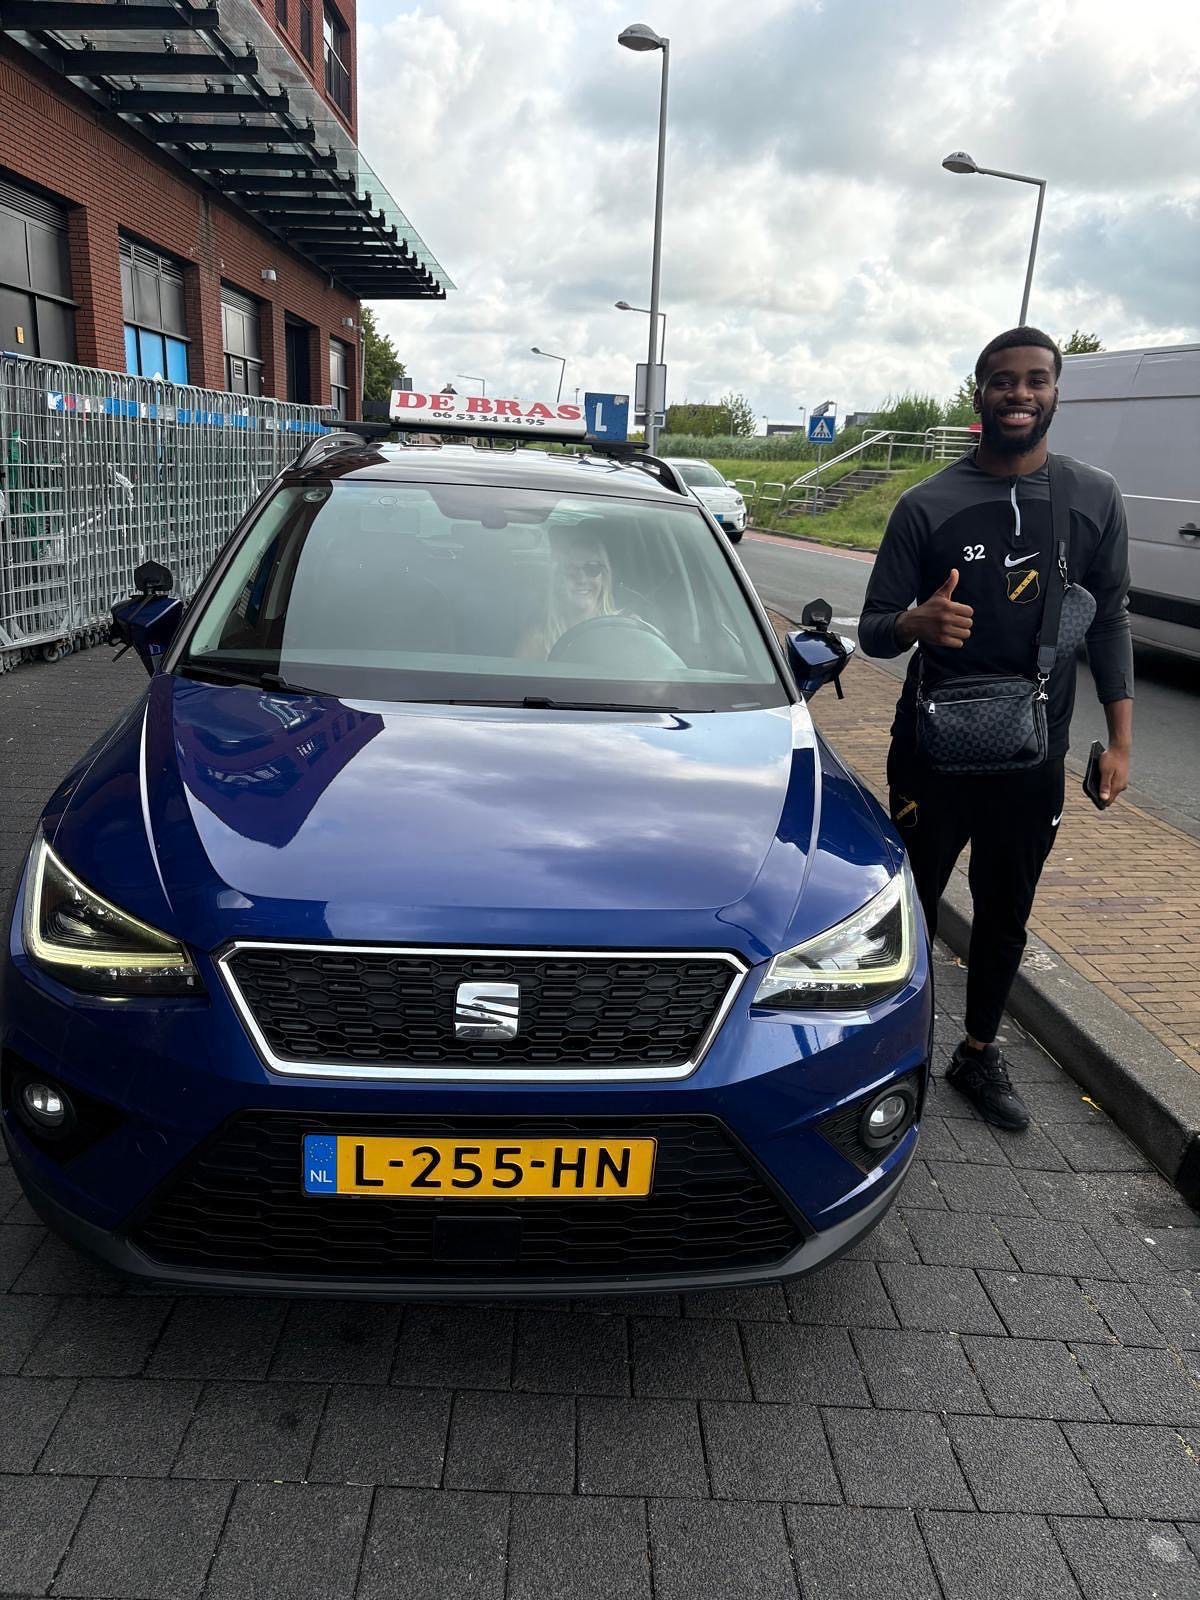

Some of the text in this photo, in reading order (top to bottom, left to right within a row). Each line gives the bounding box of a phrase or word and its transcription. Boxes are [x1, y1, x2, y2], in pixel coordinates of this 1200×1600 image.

[395, 392, 581, 420] DE BRAS
[595, 402, 607, 432] L
[456, 413, 476, 421] 53
[479, 415, 498, 423] 34
[503, 416, 521, 425] 14
[525, 418, 545, 426] 95
[962, 543, 986, 562] 32
[310, 1169, 333, 1183] NL
[355, 1144, 631, 1189] L-255-HN
